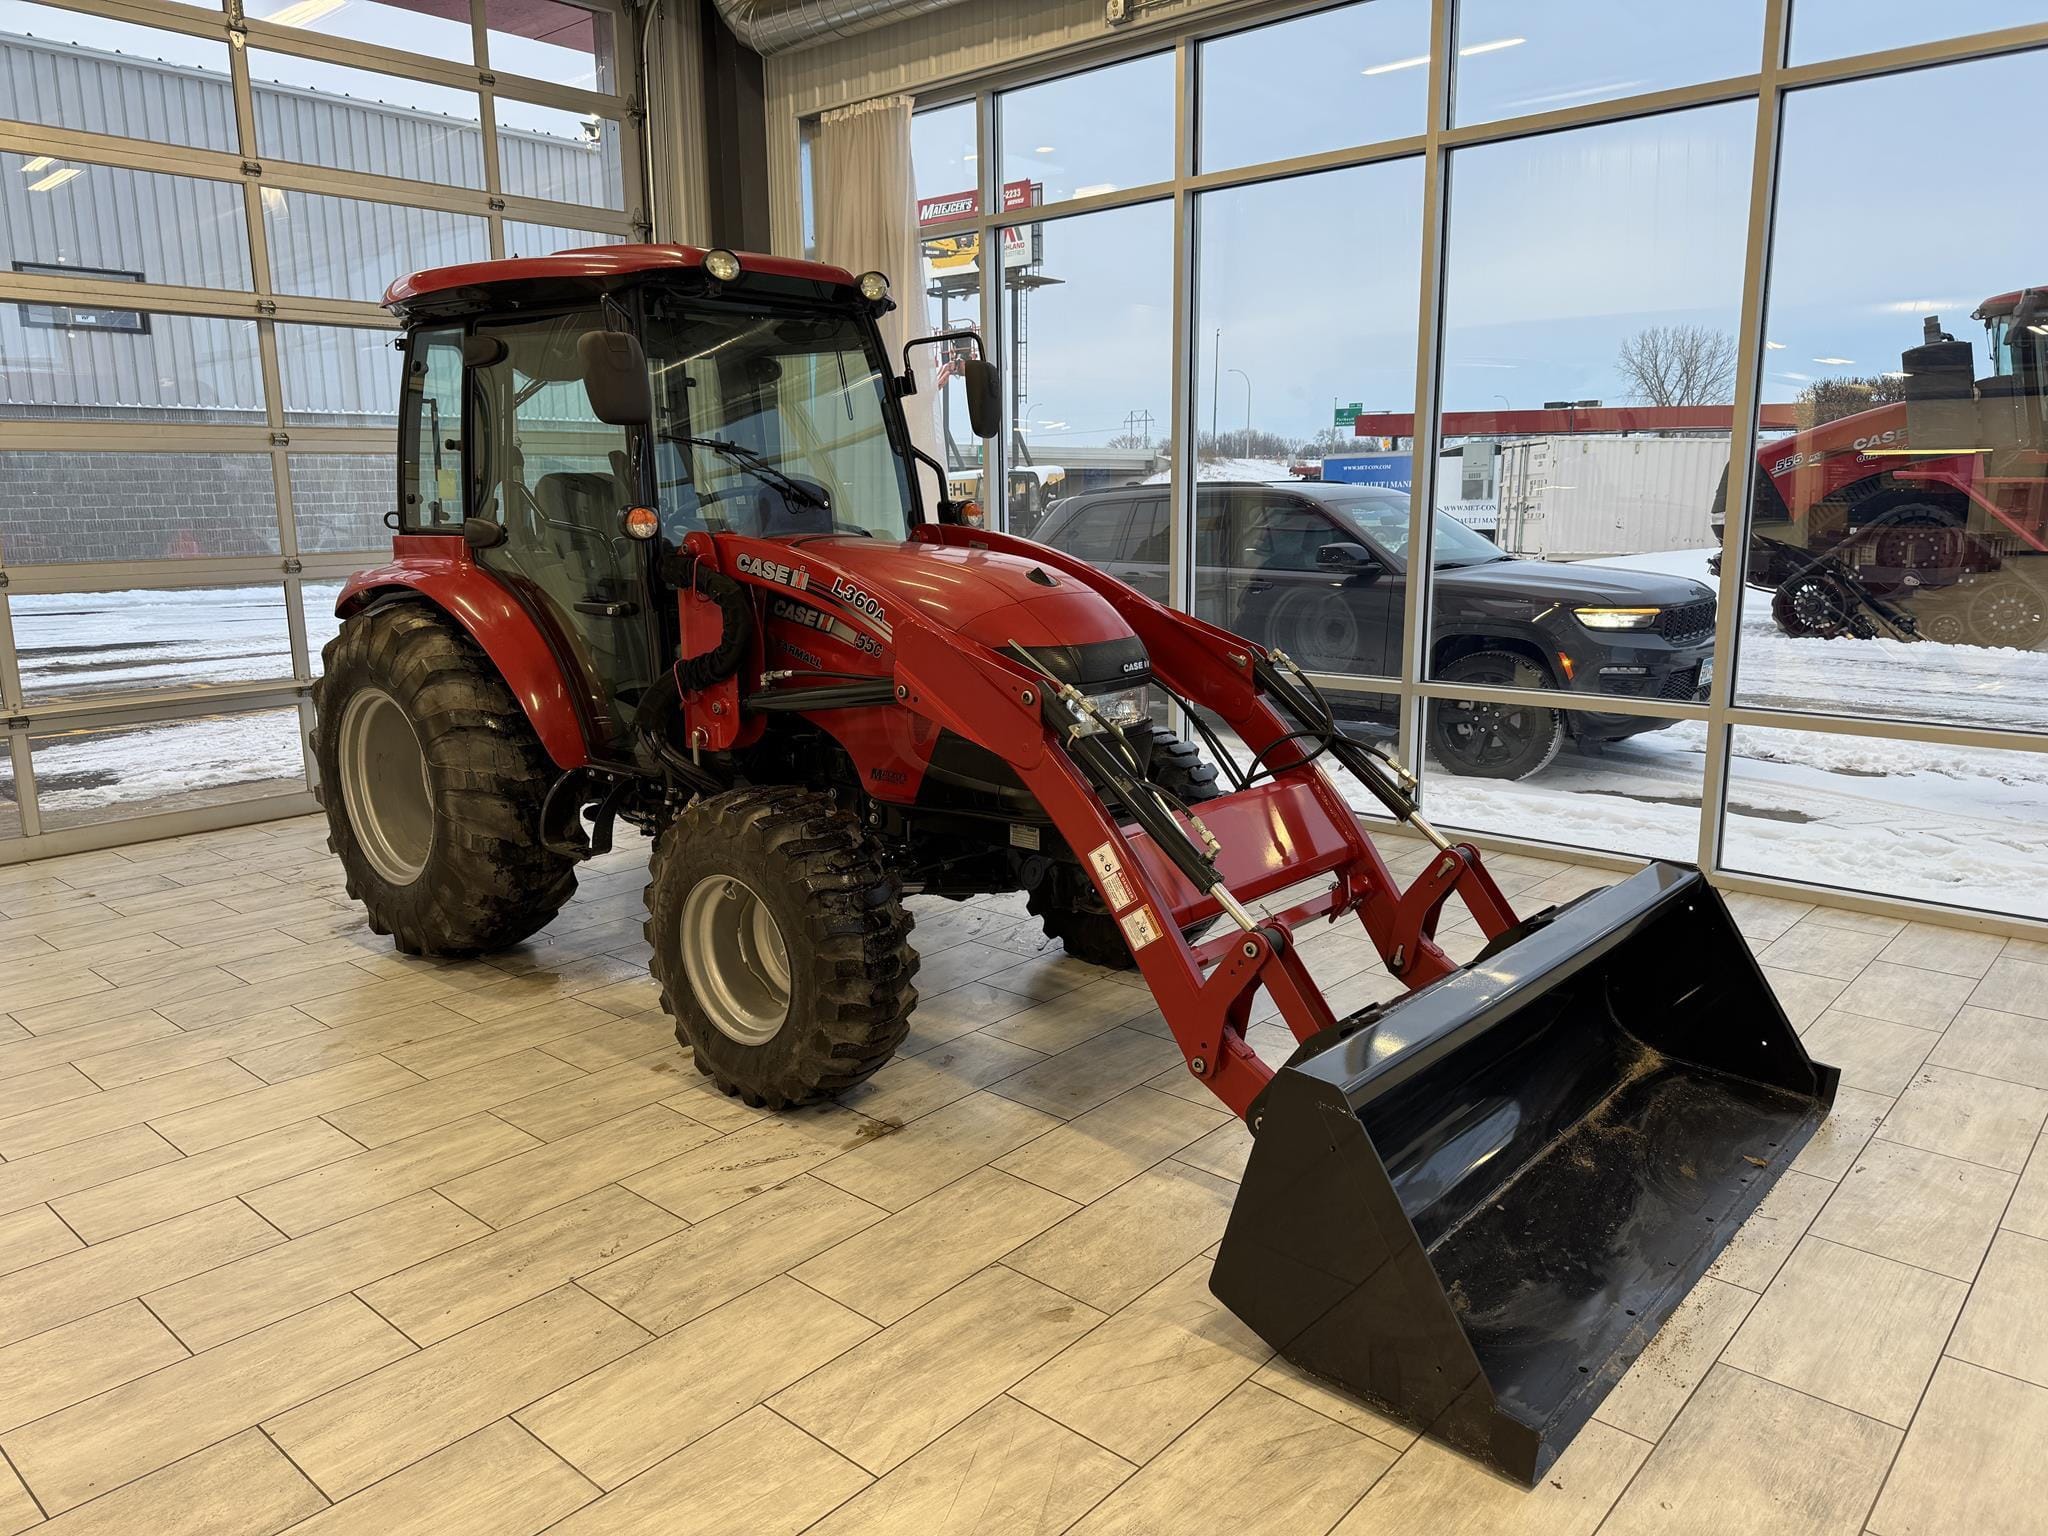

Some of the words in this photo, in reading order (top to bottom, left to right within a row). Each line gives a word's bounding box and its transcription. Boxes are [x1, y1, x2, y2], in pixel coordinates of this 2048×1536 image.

[1776, 452, 1804, 470] 555
[736, 553, 789, 585] CASE
[831, 576, 886, 624] L360A
[774, 600, 818, 627] CASE
[855, 632, 884, 658] 55C
[1123, 661, 1143, 672] CASE
